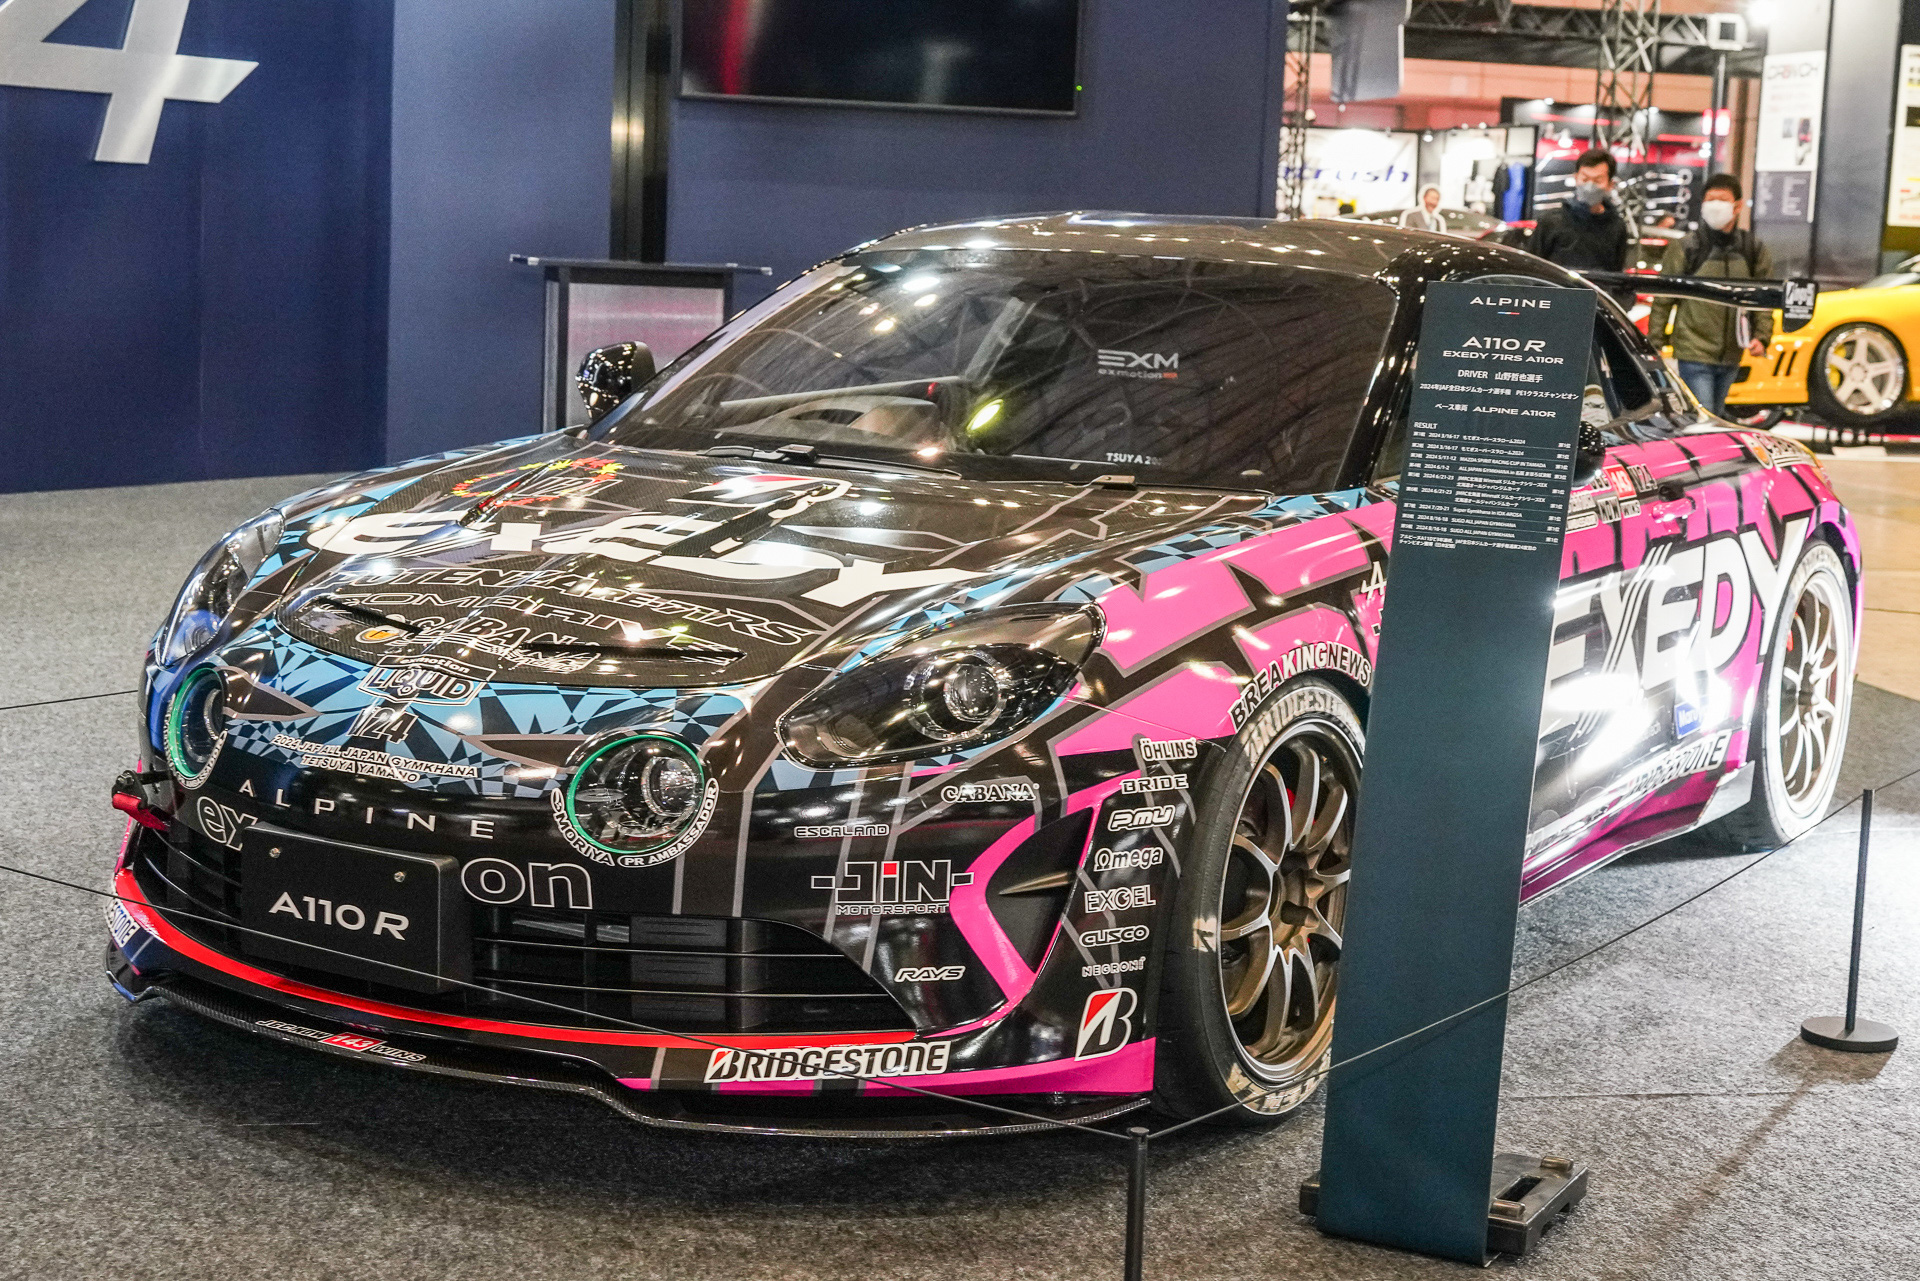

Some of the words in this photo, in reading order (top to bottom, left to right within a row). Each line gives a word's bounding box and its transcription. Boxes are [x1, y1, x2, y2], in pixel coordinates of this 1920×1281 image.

[1470, 297, 1551, 309] ALPINE
[1462, 336, 1521, 350] A110
[1524, 340, 1546, 352] R
[1098, 349, 1179, 369] EXM
[1443, 350, 1488, 360] EXEDY
[1491, 353, 1523, 362] 71RS
[1525, 355, 1564, 365] A110R
[1457, 369, 1489, 379] DRIVER
[1473, 406, 1518, 415] ALPINE
[1521, 409, 1557, 418] A110R
[1414, 421, 1438, 430] RESULT
[1106, 453, 1143, 464] TSUYA
[316, 568, 599, 597] POTENZA
[369, 667, 475, 700] LIQUID
[271, 734, 299, 751] 2024
[299, 740, 322, 754] JAF
[321, 745, 342, 757] ALL
[342, 746, 390, 764] JAPAN
[389, 755, 478, 778] GYMKHANA
[1140, 737, 1197, 762] ÖHLINS
[300, 754, 355, 774] TETSUYA
[355, 761, 421, 784] YAMANO
[941, 783, 1037, 803] CABANA
[1120, 774, 1189, 794] BRIDE
[239, 779, 495, 840] ALPINE
[623, 855, 645, 868] PR
[646, 784, 719, 866] AMBASSADOR
[794, 824, 890, 838] ESCALAND
[553, 809, 616, 867] MORIYA
[269, 892, 366, 930] A110
[372, 911, 410, 940] R
[835, 903, 950, 916] MOTORSPORT
[1079, 925, 1150, 948] CUSCO
[894, 965, 966, 982] RAYS
[1082, 957, 1145, 977] NEGRONI
[370, 1045, 427, 1062] WINS
[705, 1041, 950, 1083] BRIDGESTONE
